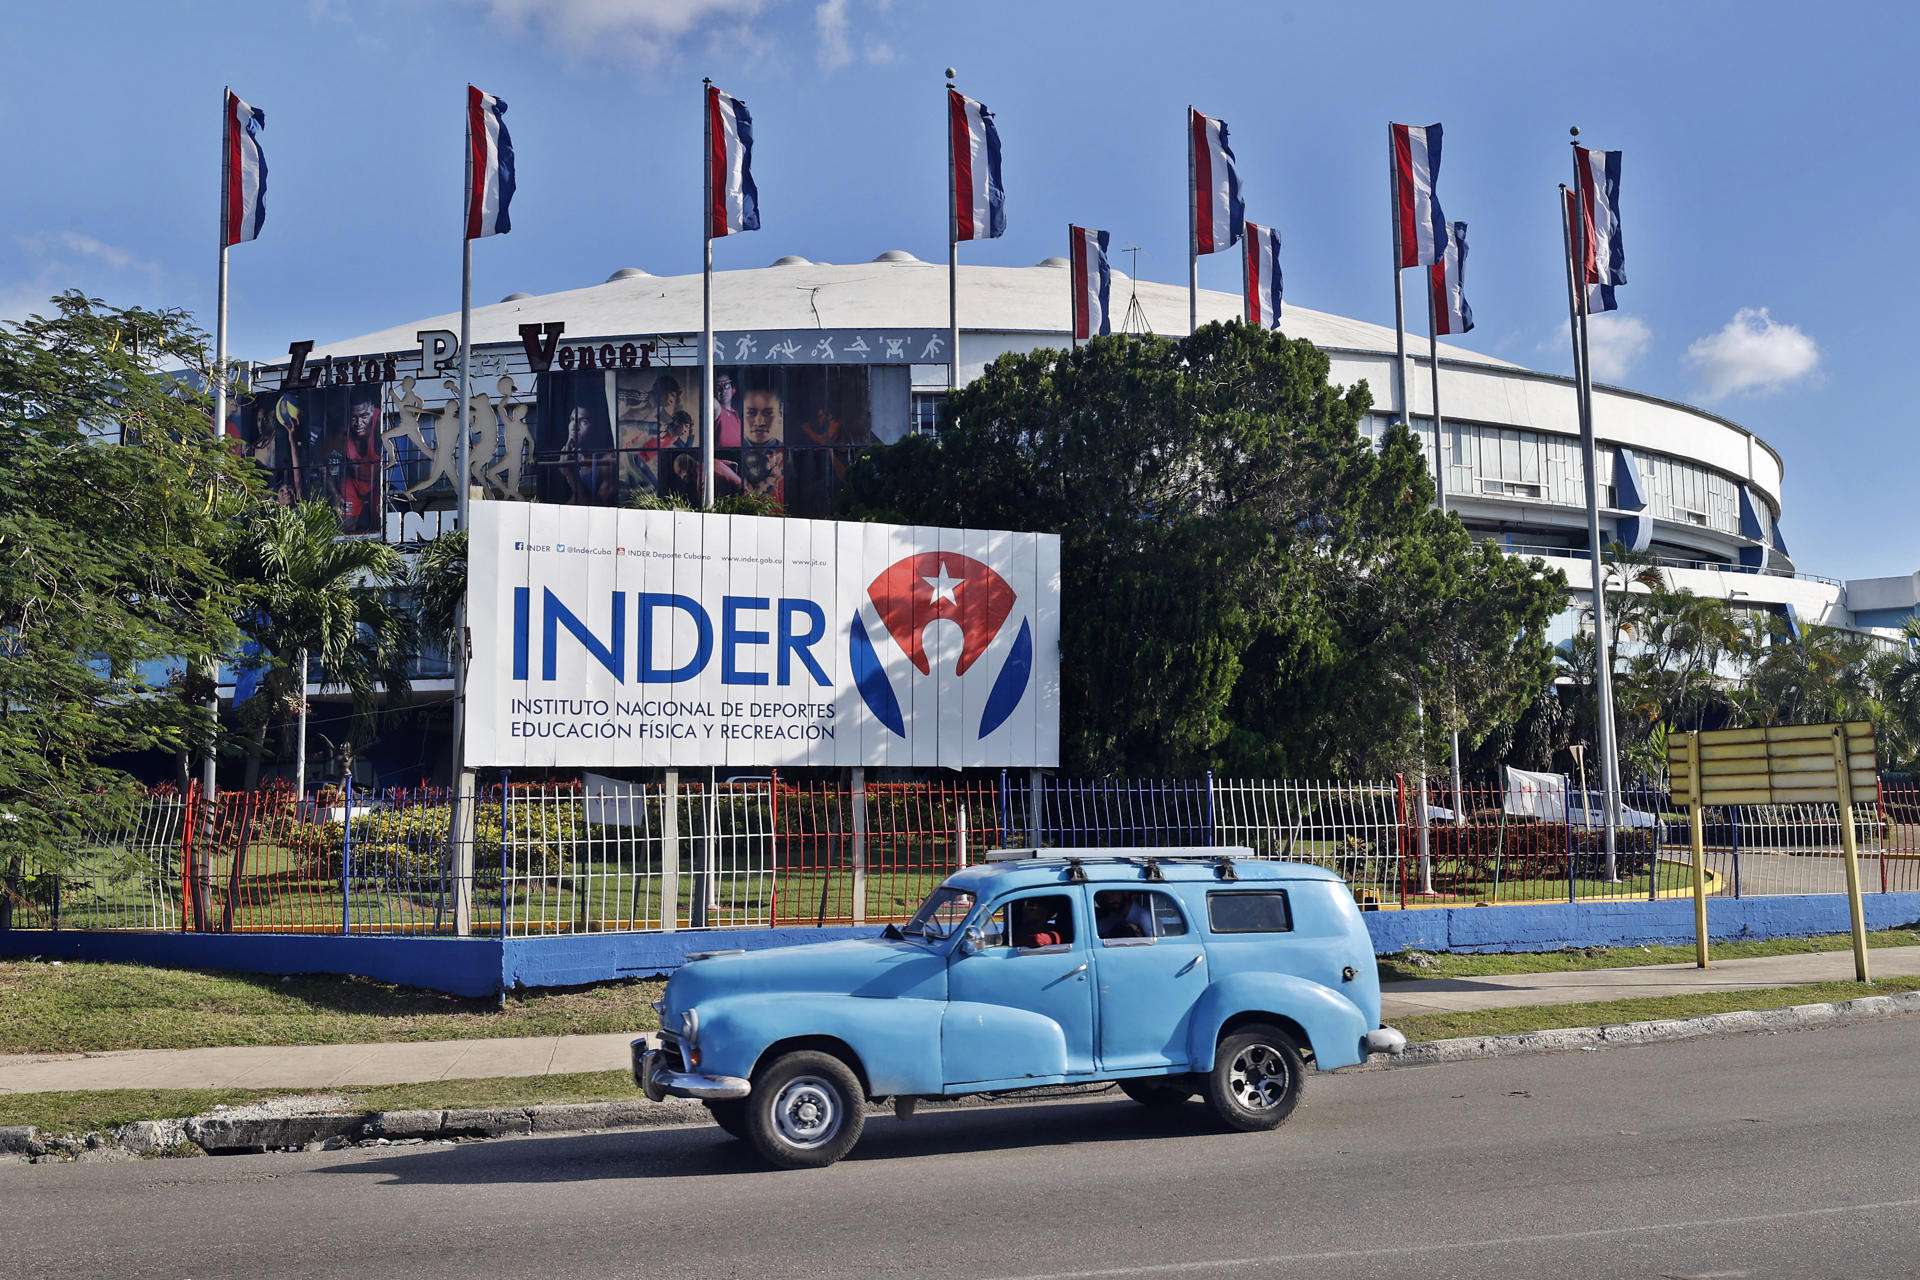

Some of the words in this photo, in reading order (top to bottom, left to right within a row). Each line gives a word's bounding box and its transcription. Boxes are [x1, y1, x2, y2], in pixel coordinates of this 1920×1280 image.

[281, 340, 397, 389] Listos
[519, 321, 656, 373] Vencer
[527, 544, 551, 552] INDER
[567, 546, 612, 555] @InderCuba
[652, 552, 681, 560] Deporte
[721, 555, 782, 565] www.inder.gob.cu
[513, 585, 834, 687] INDER
[511, 698, 609, 716] INSTITUTO
[616, 701, 715, 717] NACIONAL
[722, 702, 743, 717] DE
[750, 703, 835, 719] DEPORTES
[511, 719, 632, 739] EDUCACIÓN
[640, 720, 697, 739] FÍSICA
[703, 724, 714, 739] Y
[721, 721, 835, 740] RECREACIÓN
